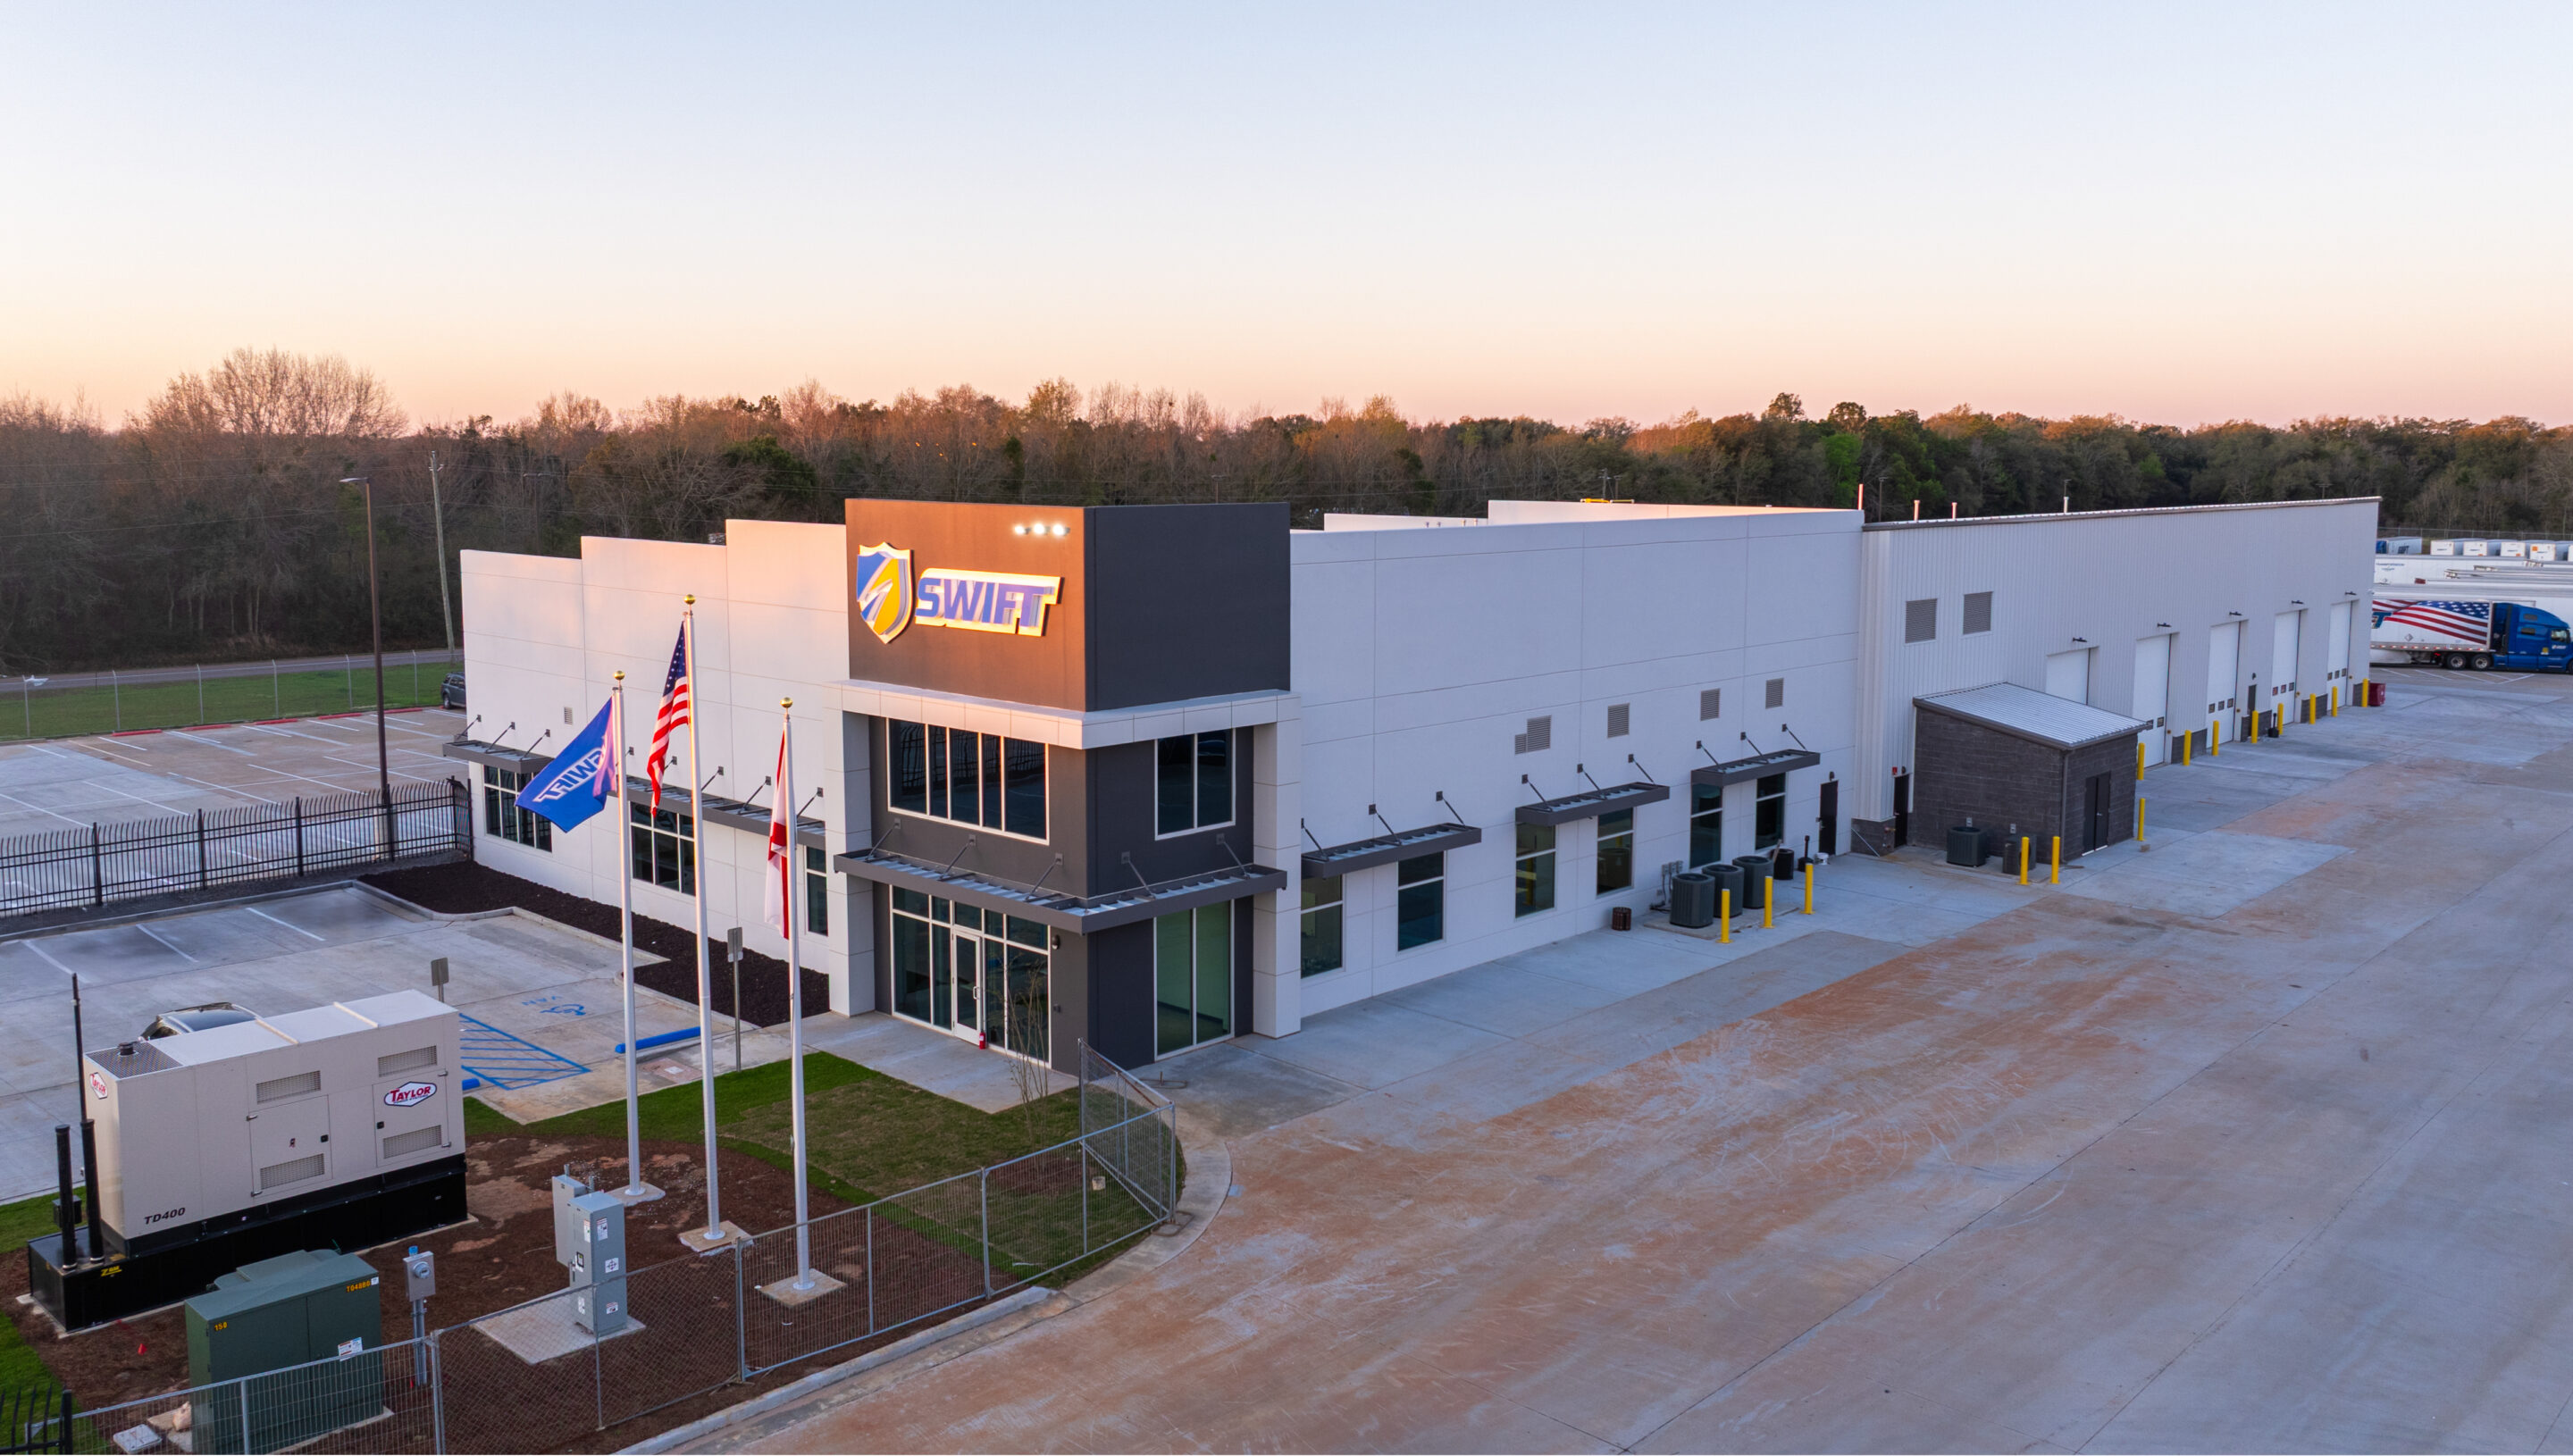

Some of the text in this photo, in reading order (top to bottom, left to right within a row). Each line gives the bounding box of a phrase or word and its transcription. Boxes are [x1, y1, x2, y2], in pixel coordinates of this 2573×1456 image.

[915, 573, 1055, 629] SWIFT
[390, 1086, 431, 1102] TAYLOR
[144, 1208, 186, 1225] TD400
